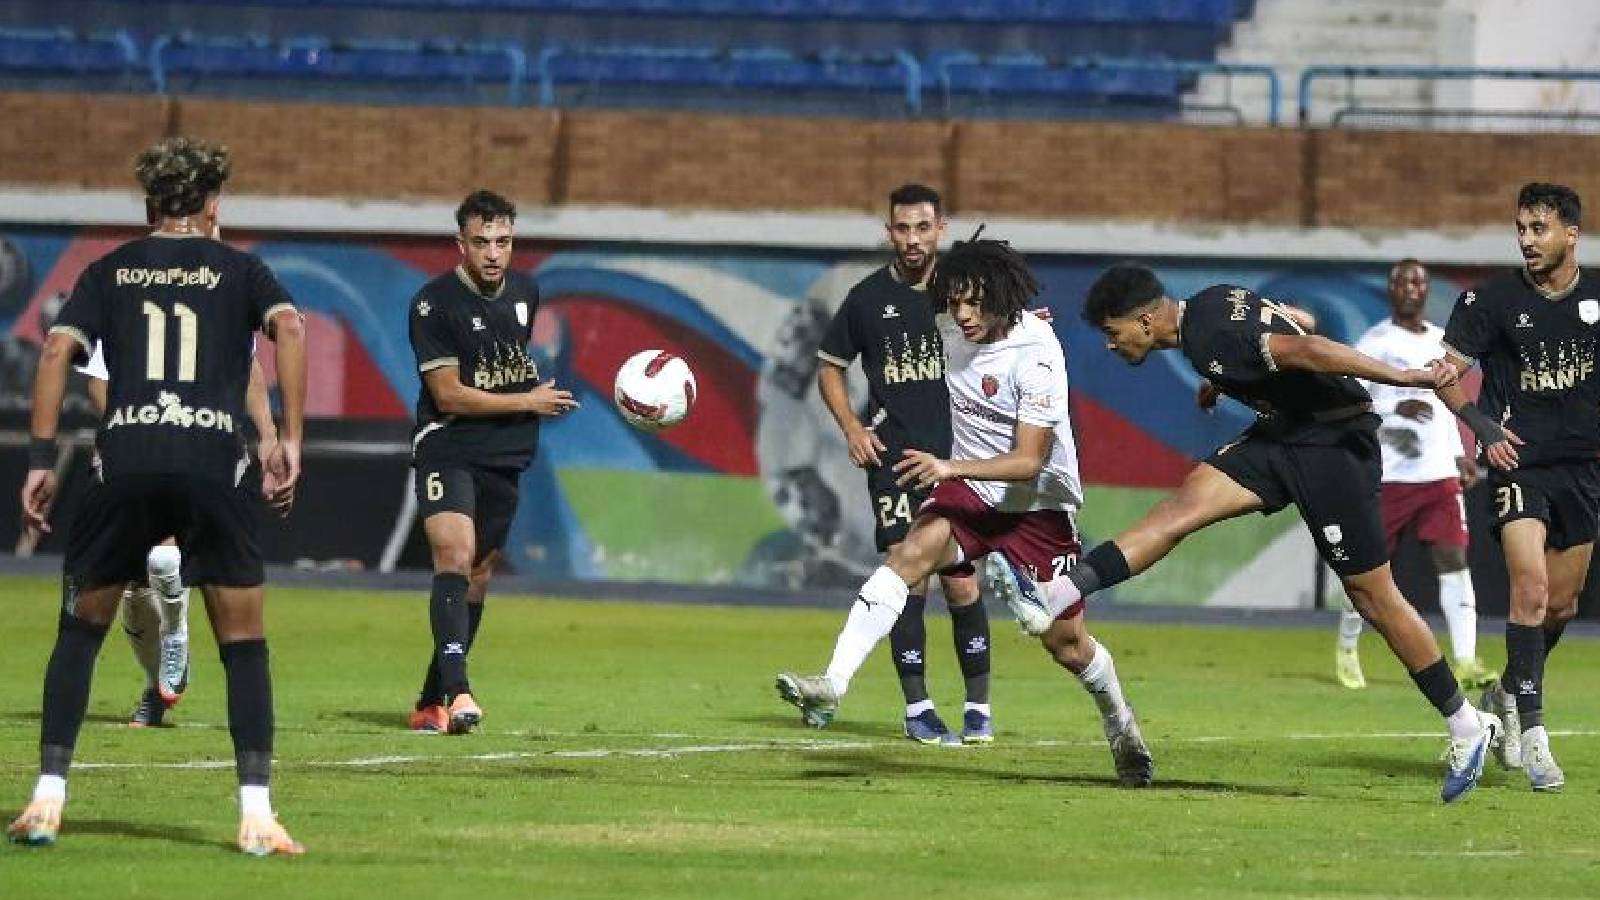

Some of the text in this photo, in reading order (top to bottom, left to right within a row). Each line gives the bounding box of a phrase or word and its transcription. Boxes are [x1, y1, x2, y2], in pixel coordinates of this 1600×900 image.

[143, 300, 198, 381] 11
[426, 472, 444, 501] 6
[1496, 482, 1524, 518] 31
[878, 493, 912, 527] 24
